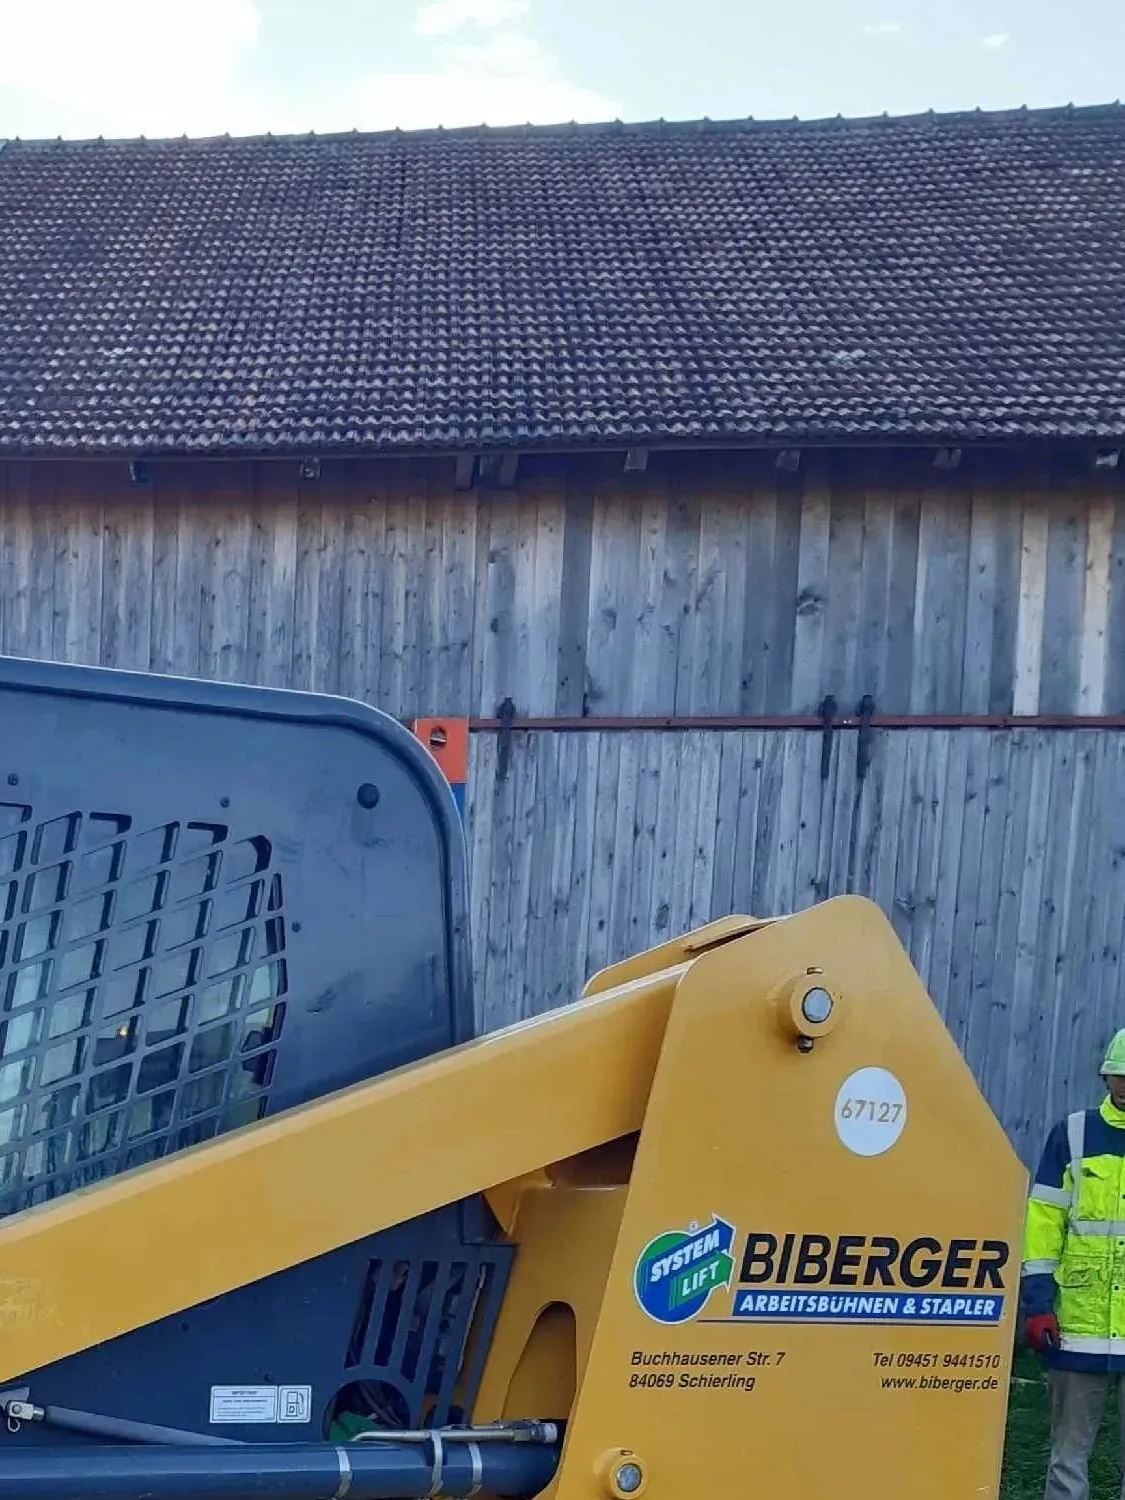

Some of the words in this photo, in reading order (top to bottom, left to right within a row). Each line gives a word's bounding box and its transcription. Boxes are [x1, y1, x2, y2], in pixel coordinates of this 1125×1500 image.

[841, 1099, 902, 1122] 67127
[650, 1229, 720, 1282] SYSTEM
[739, 1233, 1010, 1288] BIBERGER
[682, 1260, 719, 1296] LIFT
[740, 1294, 898, 1314] ARBEITSBÜHNEN
[902, 1297, 916, 1315] &
[920, 1298, 995, 1316] STAPLER
[631, 1351, 743, 1366] Buchhausener
[746, 1351, 771, 1366] Str.
[775, 1352, 786, 1366] 7
[873, 1353, 894, 1367] Tel
[897, 1353, 938, 1367] 09451
[943, 1354, 1001, 1368] 9441510
[629, 1373, 675, 1388] 84069
[678, 1374, 756, 1392] Schierling
[881, 1376, 999, 1392] www.biberger.de
